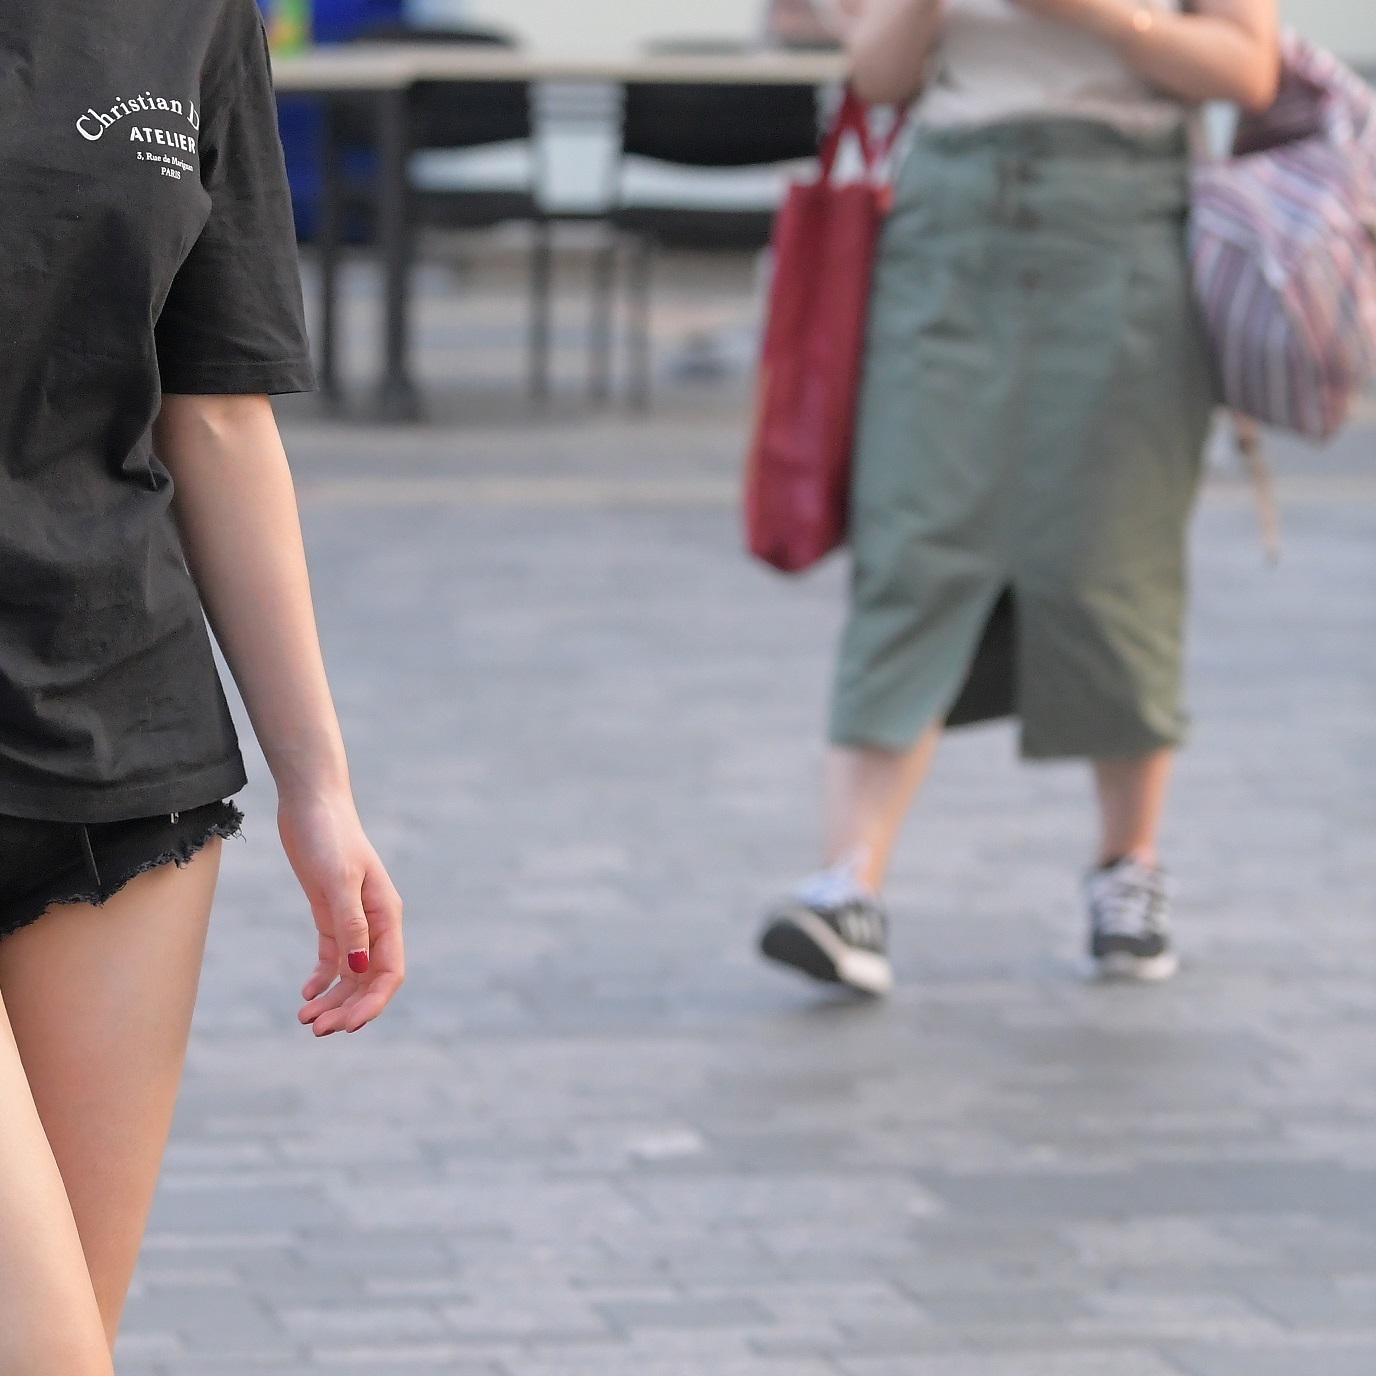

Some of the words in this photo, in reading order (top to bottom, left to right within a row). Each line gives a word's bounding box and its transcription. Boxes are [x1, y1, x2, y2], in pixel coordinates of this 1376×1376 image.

[76, 90, 183, 141] Christian
[129, 126, 196, 154] ATELIER
[145, 151, 162, 162] Rue
[160, 166, 181, 180] PARIS
